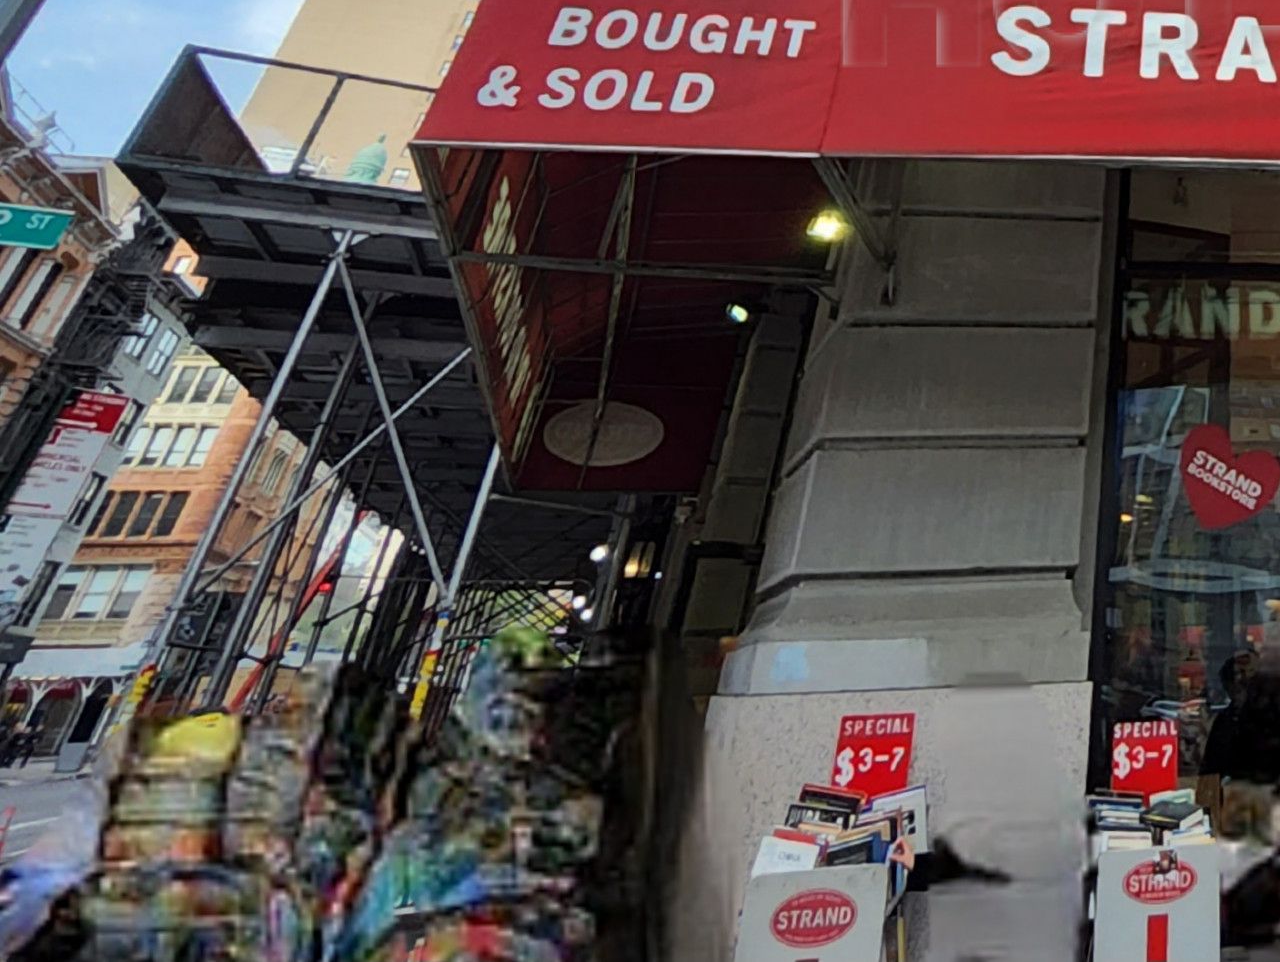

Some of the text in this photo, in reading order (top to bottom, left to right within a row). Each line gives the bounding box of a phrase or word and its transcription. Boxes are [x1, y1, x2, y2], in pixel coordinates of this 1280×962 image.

[547, 6, 816, 58] BOUGHT
[476, 64, 715, 114] & SOLD
[25, 214, 56, 230] ST
[1186, 462, 1258, 511] BOOKSTORE
[1191, 450, 1262, 498] STRAND
[843, 717, 910, 736] SPECIAL
[1113, 720, 1178, 739] SPECIAL
[835, 746, 905, 787] $3-7
[1112, 742, 1173, 780] $3-7
[776, 906, 852, 931] STRAND
